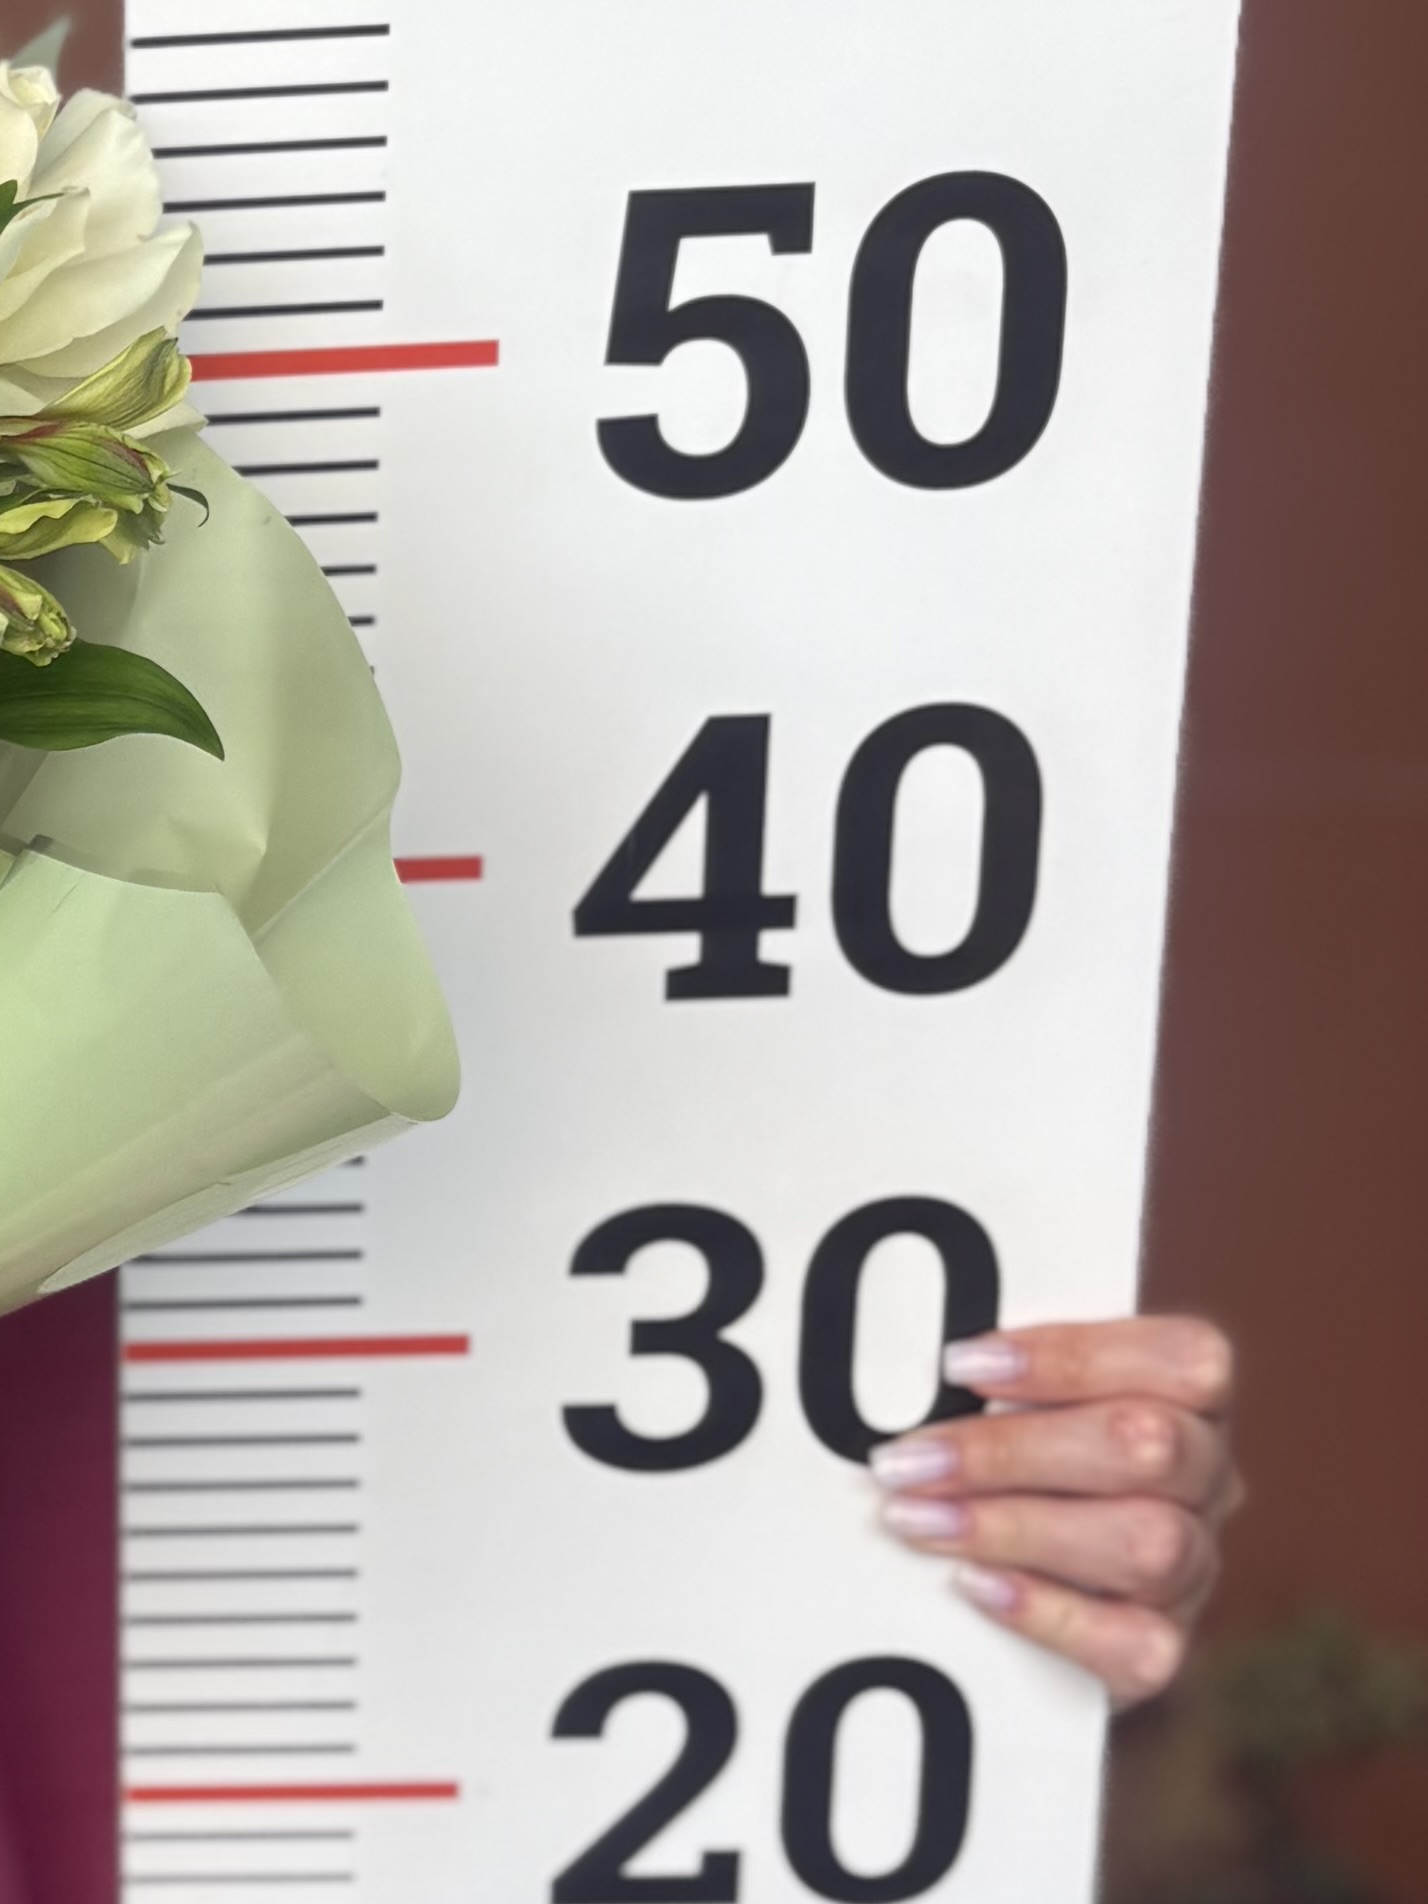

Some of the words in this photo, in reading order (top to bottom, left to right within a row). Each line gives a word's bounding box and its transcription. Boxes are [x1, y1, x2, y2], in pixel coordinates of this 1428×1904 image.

[596, 169, 1069, 501] 50
[572, 701, 1044, 1002] 40
[561, 1195, 1002, 1474] 30
